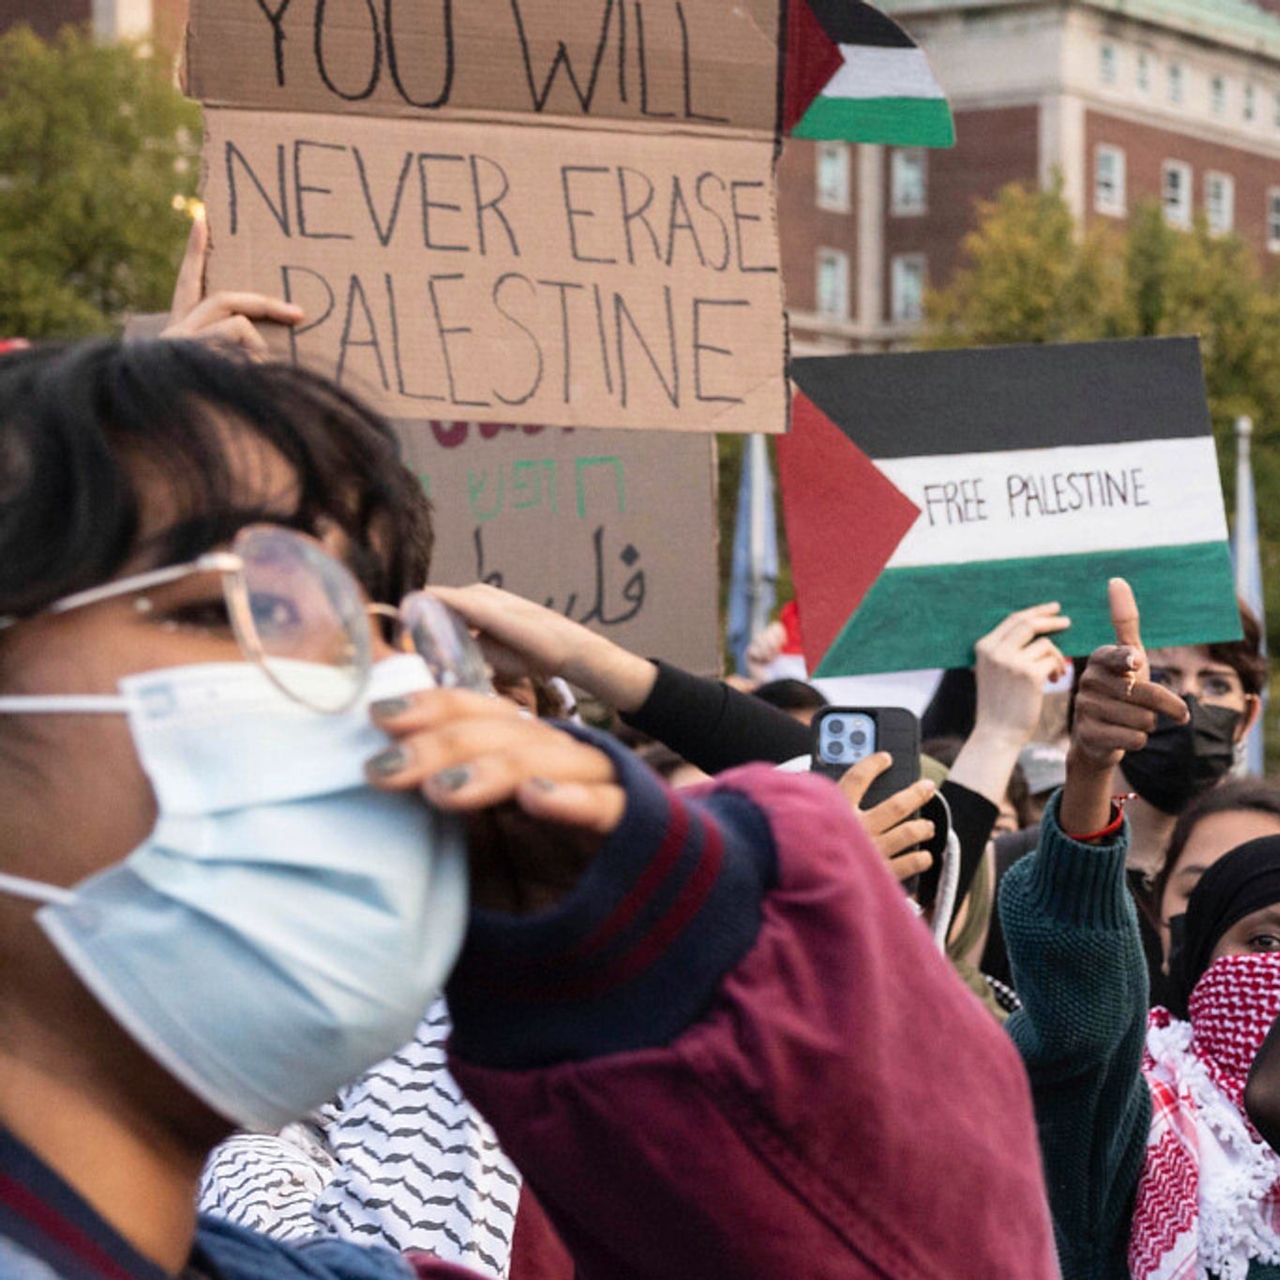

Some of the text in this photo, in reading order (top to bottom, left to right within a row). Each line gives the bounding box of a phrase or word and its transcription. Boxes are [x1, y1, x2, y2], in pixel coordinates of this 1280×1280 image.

[257, 0, 730, 123] YOU WILL
[225, 139, 778, 273] NEVER ERASE
[281, 265, 751, 408] PALESTINE
[923, 467, 1151, 527] FREE PALESTINE
